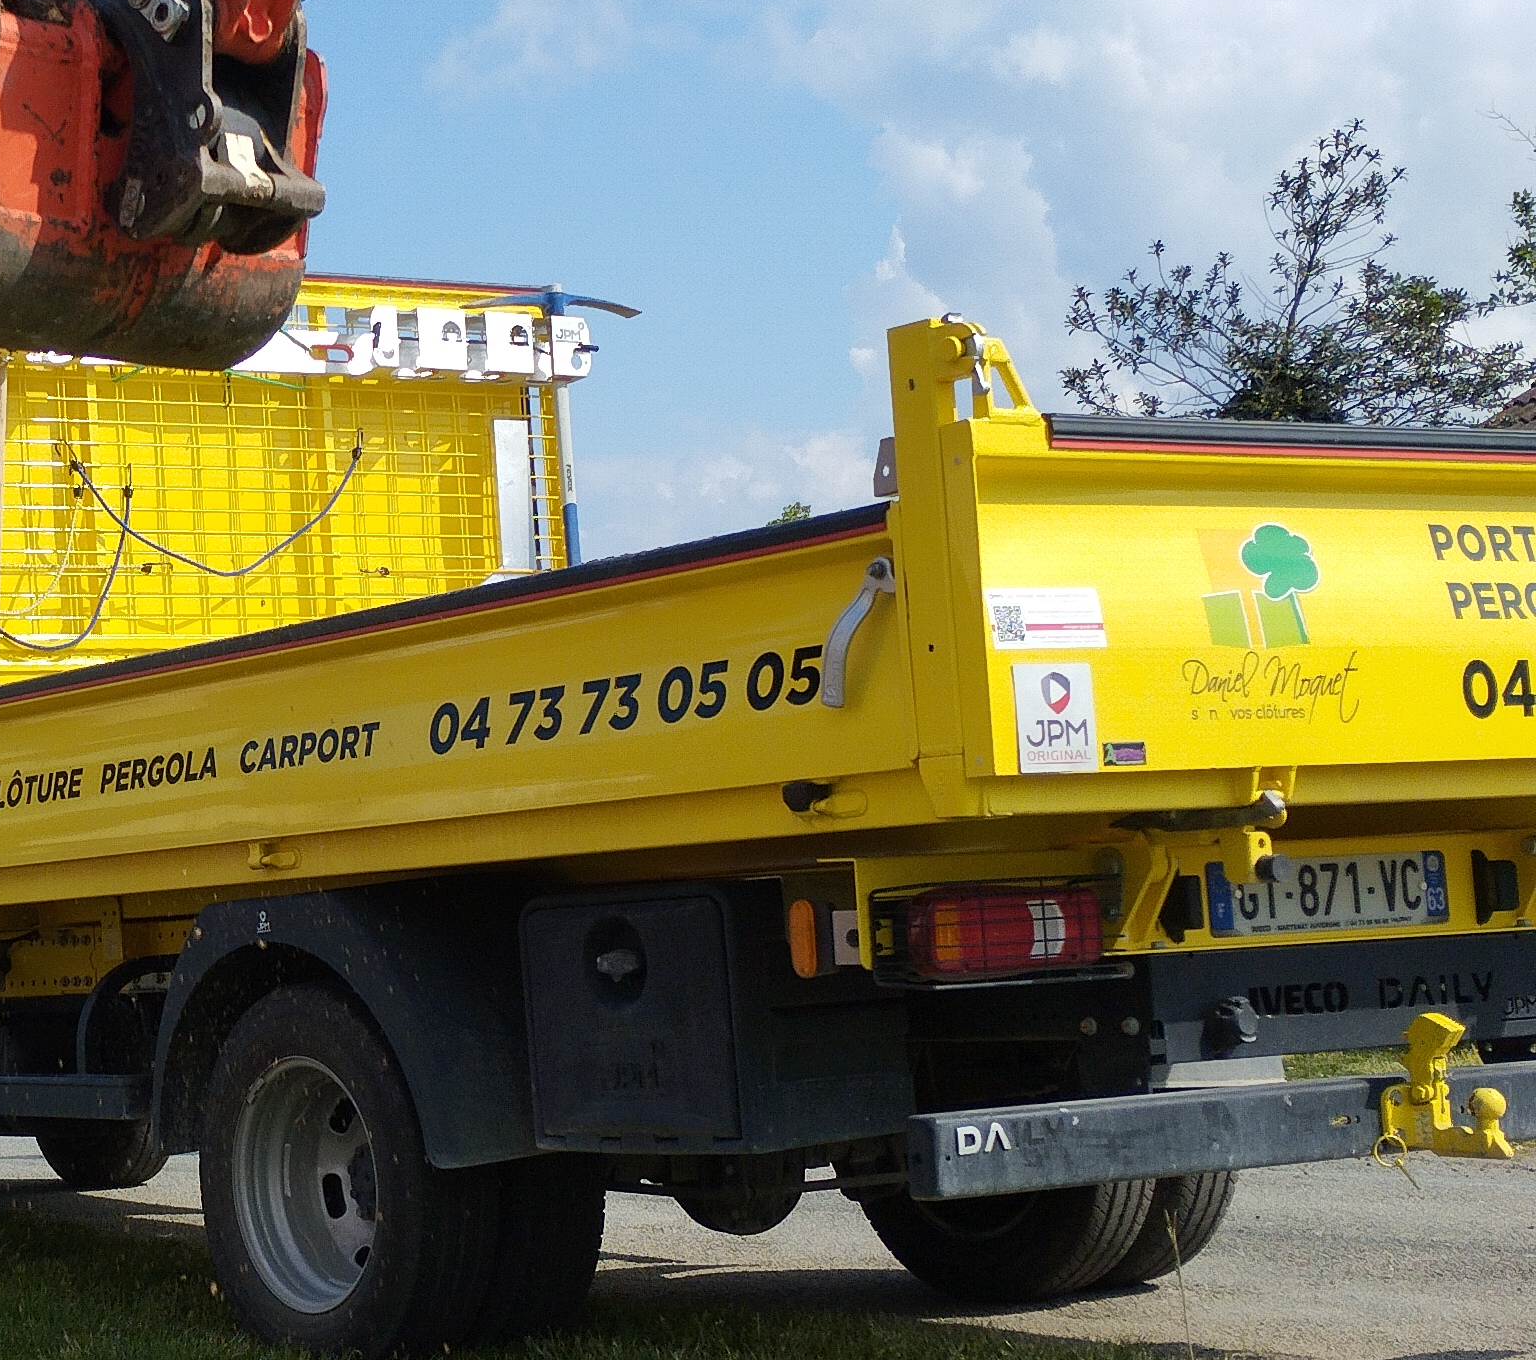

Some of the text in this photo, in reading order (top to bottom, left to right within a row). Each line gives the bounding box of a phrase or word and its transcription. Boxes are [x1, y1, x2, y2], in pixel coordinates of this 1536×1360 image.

[556, 329, 581, 340] JPM
[430, 645, 823, 755] 04 73 73 05 05
[1182, 650, 1359, 725] Daniel Moquet
[1463, 660, 1536, 719] 04
[1026, 719, 1089, 747] JPM
[1027, 749, 1091, 761] ORIGINAL
[100, 747, 217, 794] PERGOLA
[239, 722, 380, 773] CARPORT
[1427, 886, 1446, 911] 63
[1248, 971, 1493, 1017] IVECO DAILY
